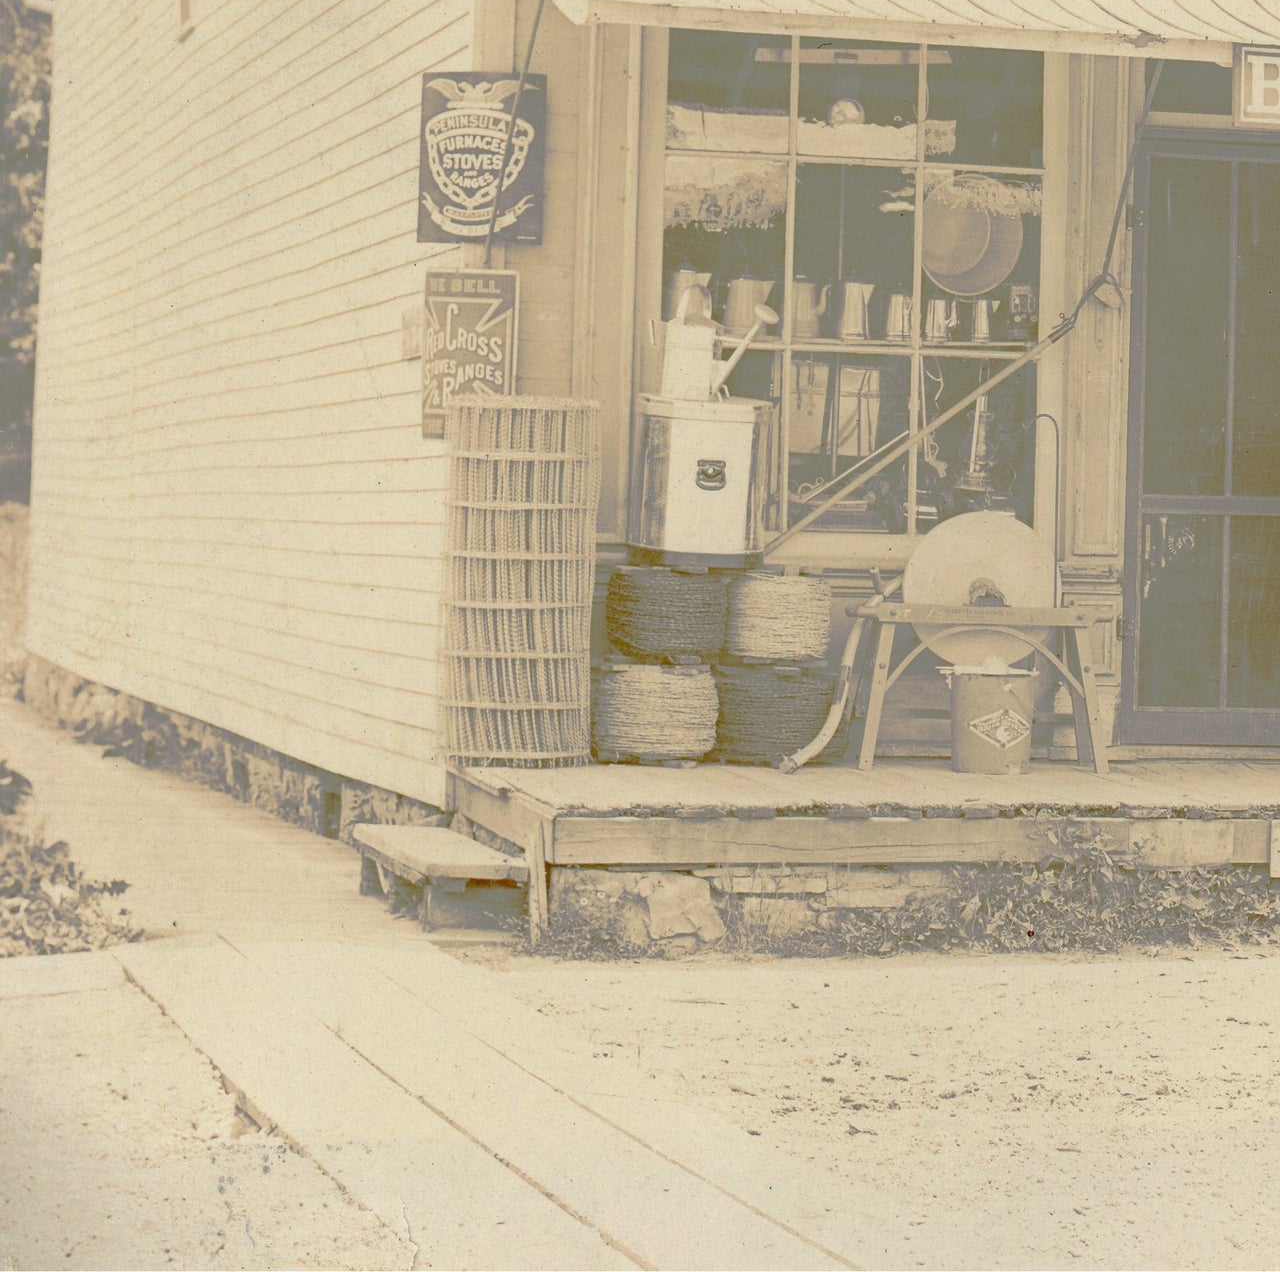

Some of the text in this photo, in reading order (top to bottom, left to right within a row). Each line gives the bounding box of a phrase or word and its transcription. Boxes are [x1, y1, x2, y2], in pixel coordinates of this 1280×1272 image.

[442, 153, 503, 169] STOVES
[450, 170, 494, 188] RANGES
[450, 279, 500, 294] SELL
[425, 302, 502, 363] RED CROSS
[442, 363, 503, 407] RANGES
